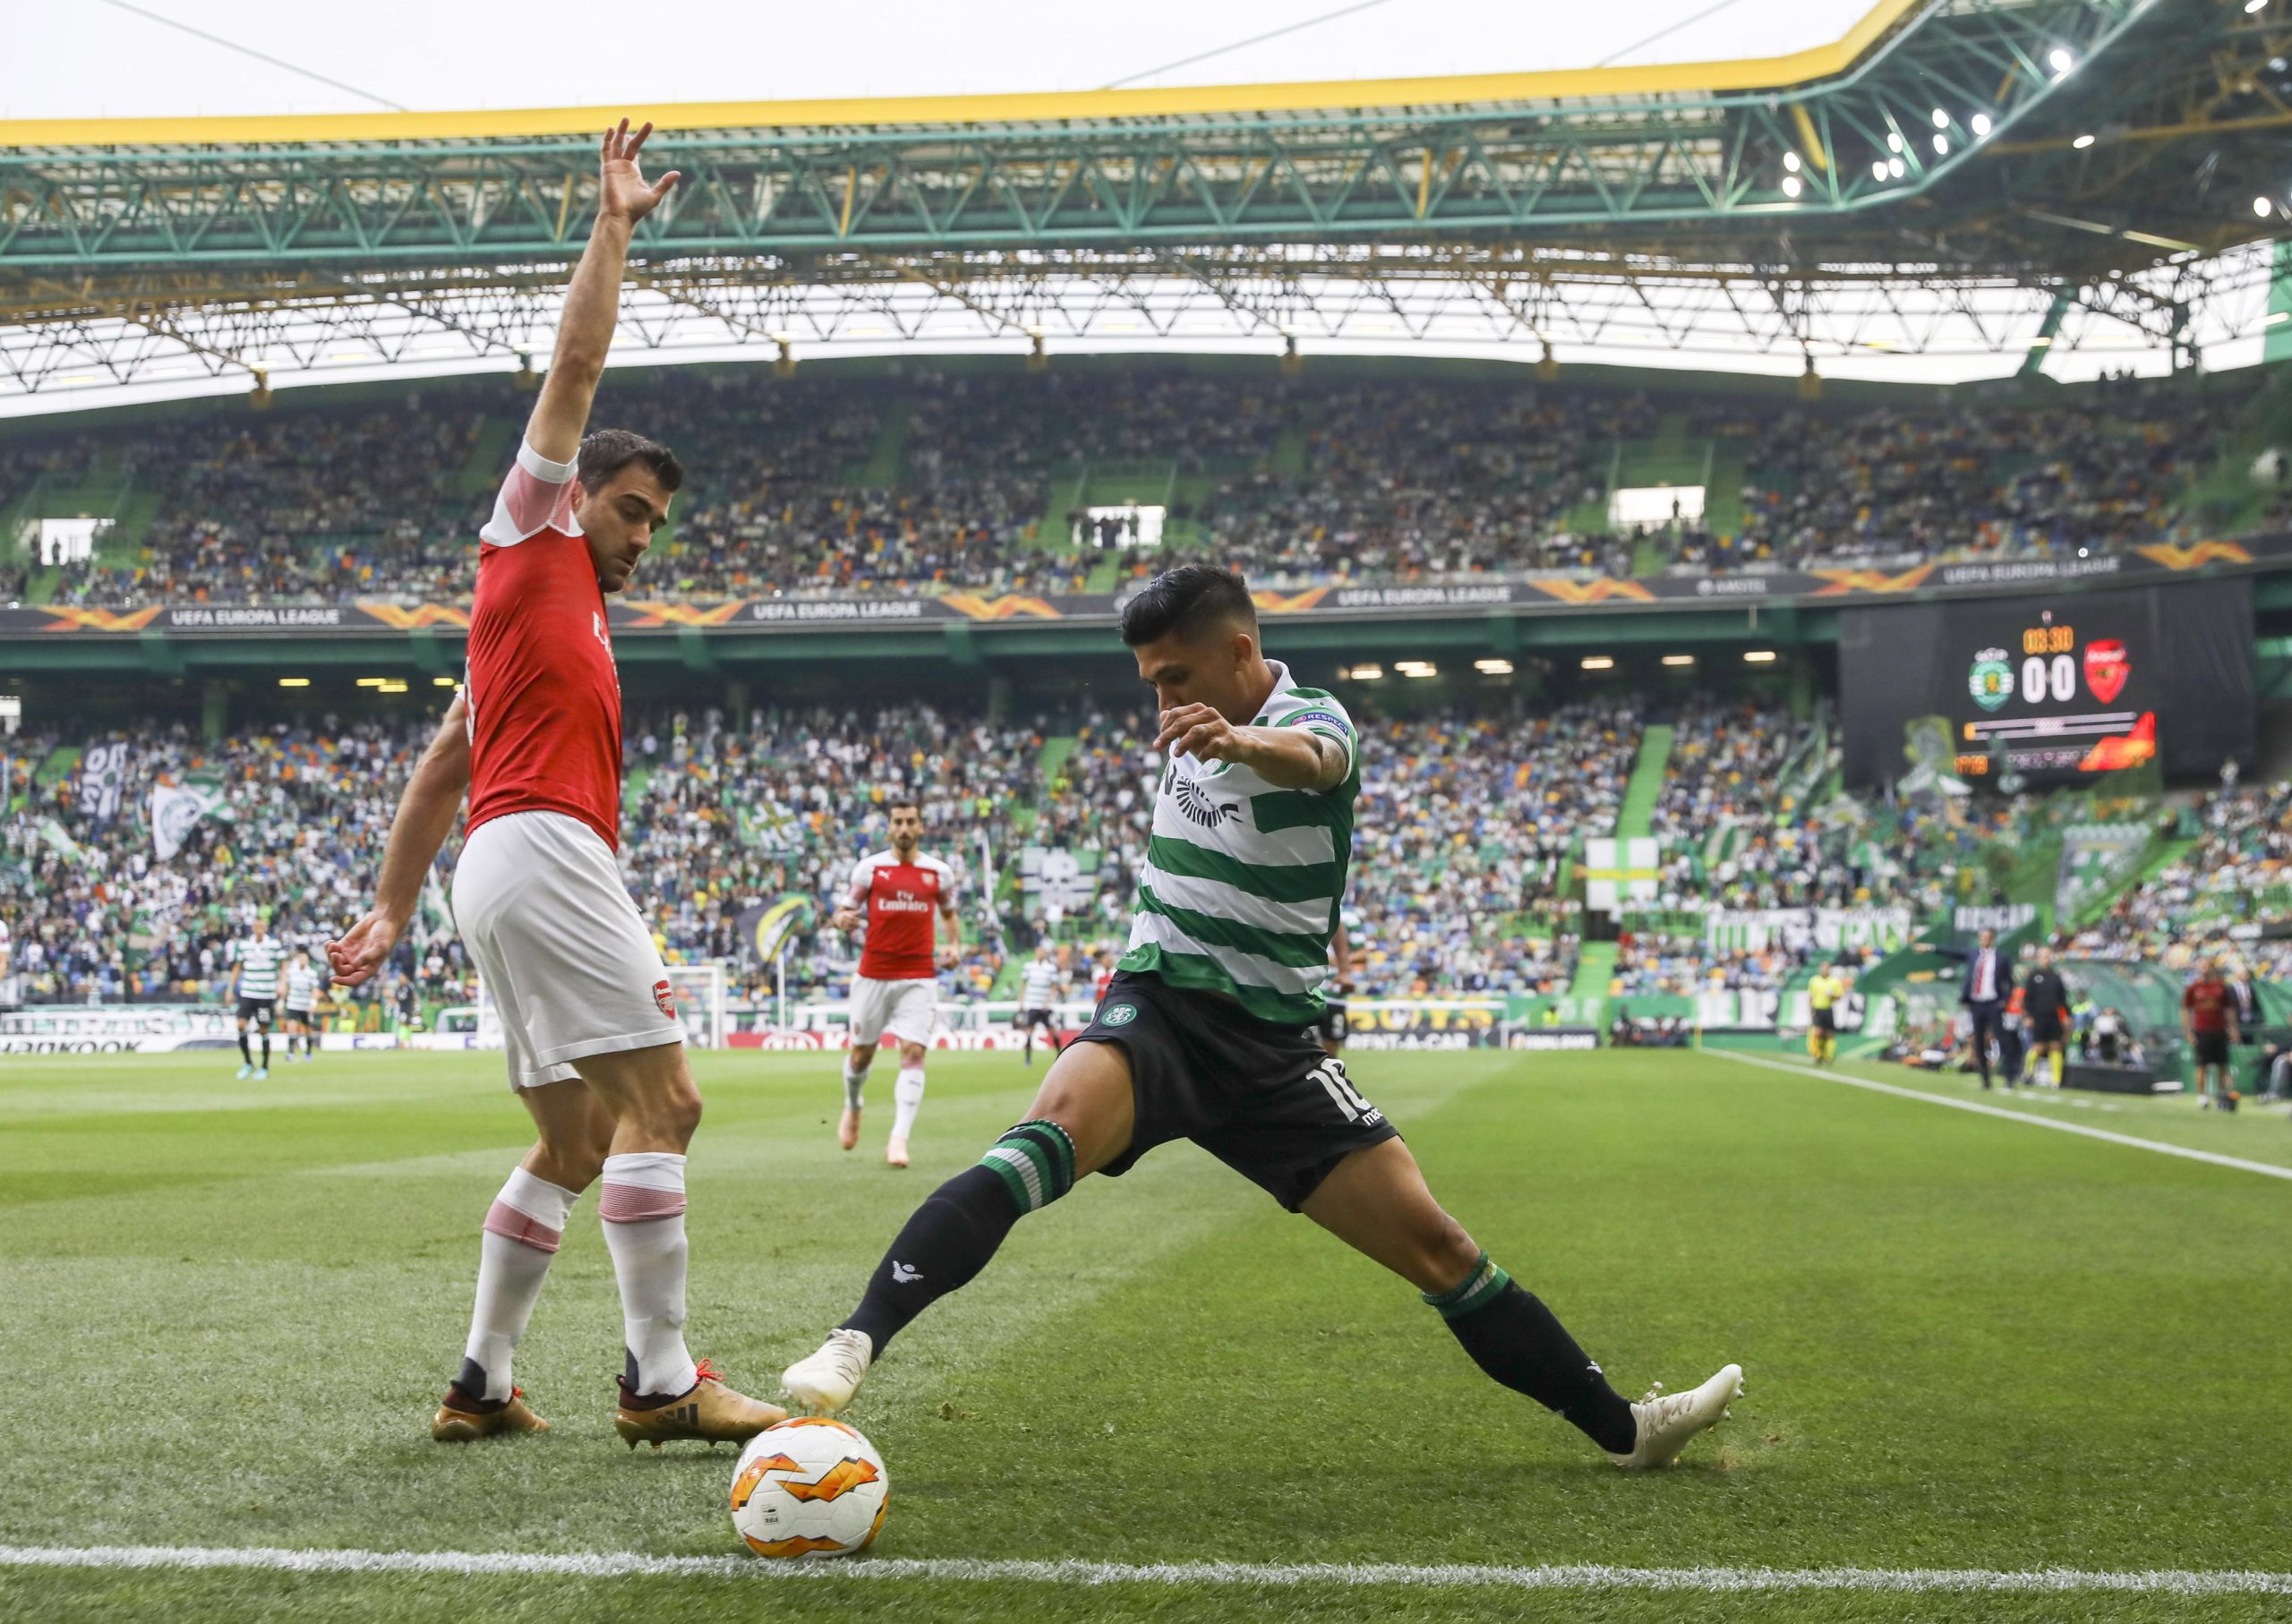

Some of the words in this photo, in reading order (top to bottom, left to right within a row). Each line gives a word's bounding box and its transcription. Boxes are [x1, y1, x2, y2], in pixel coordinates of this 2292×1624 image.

[1944, 566, 1989, 584] UEFA
[1991, 562, 2057, 579] EUROPA
[2060, 556, 2120, 576] LEAGUE
[1338, 588, 1381, 606] UEFA
[1383, 587, 1446, 606] EUROPA
[1448, 585, 1511, 603] LEAGUE
[172, 610, 214, 626] UEFA
[216, 609, 277, 625] EUROPA
[278, 608, 339, 625] LEAGUE
[753, 603, 796, 620] UEFA
[798, 603, 859, 620] EUROPA
[860, 601, 921, 618] LEAGUE
[1307, 714, 1348, 733] RESPECT
[878, 898, 928, 912] Emirates
[896, 890, 914, 902] Fly
[929, 1030, 1051, 1051] OTORS
